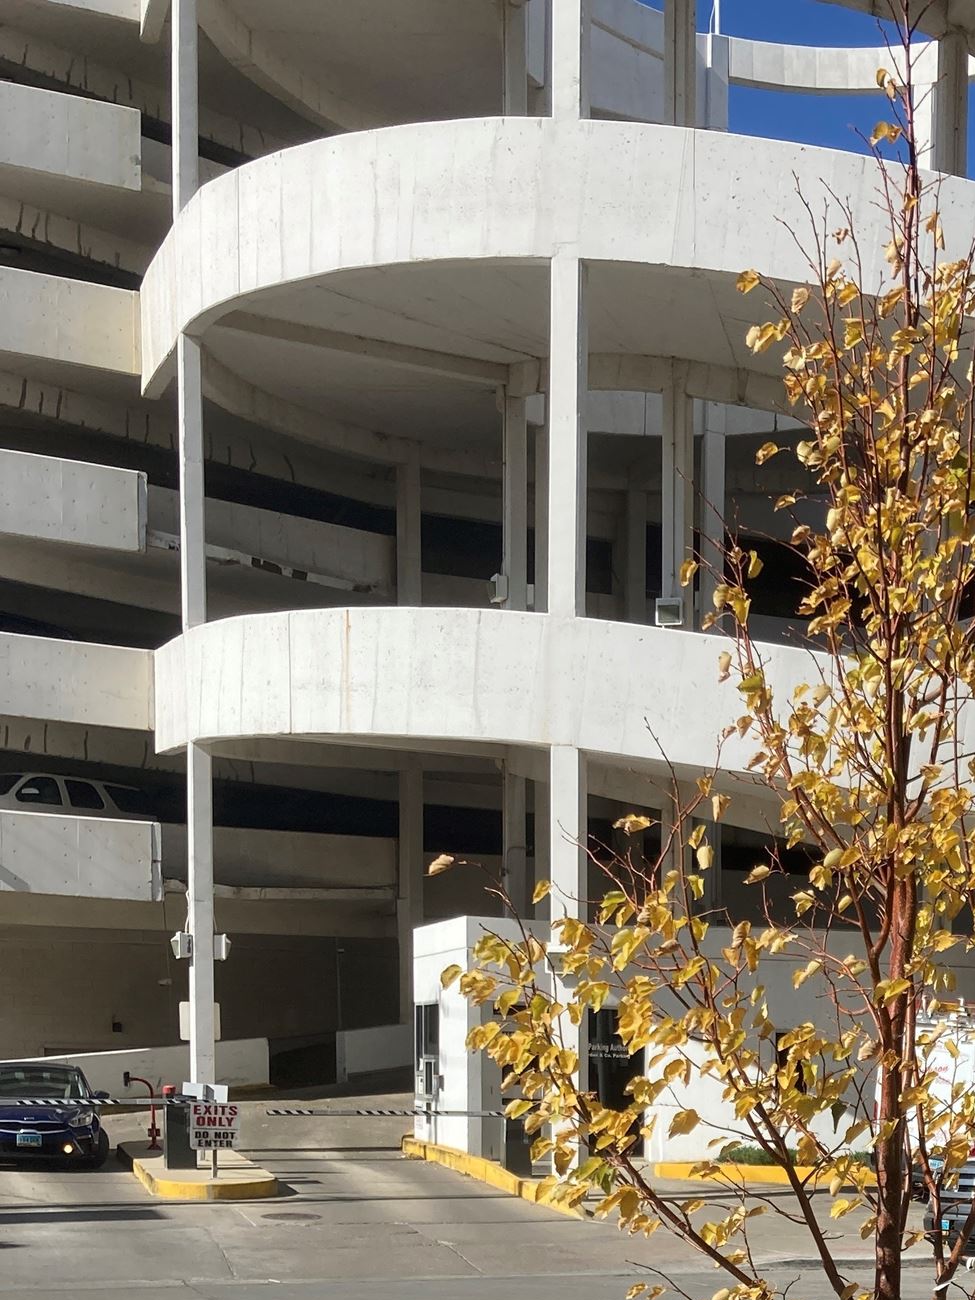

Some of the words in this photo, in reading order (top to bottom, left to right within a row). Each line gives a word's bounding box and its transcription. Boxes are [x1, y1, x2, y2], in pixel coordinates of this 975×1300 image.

[588, 1042, 609, 1053] Parking
[193, 1104, 238, 1116] EXITS
[196, 1116, 235, 1127] ONLY
[194, 1131, 209, 1139] DO
[214, 1131, 236, 1140] NOT
[197, 1139, 233, 1148] ENTER
